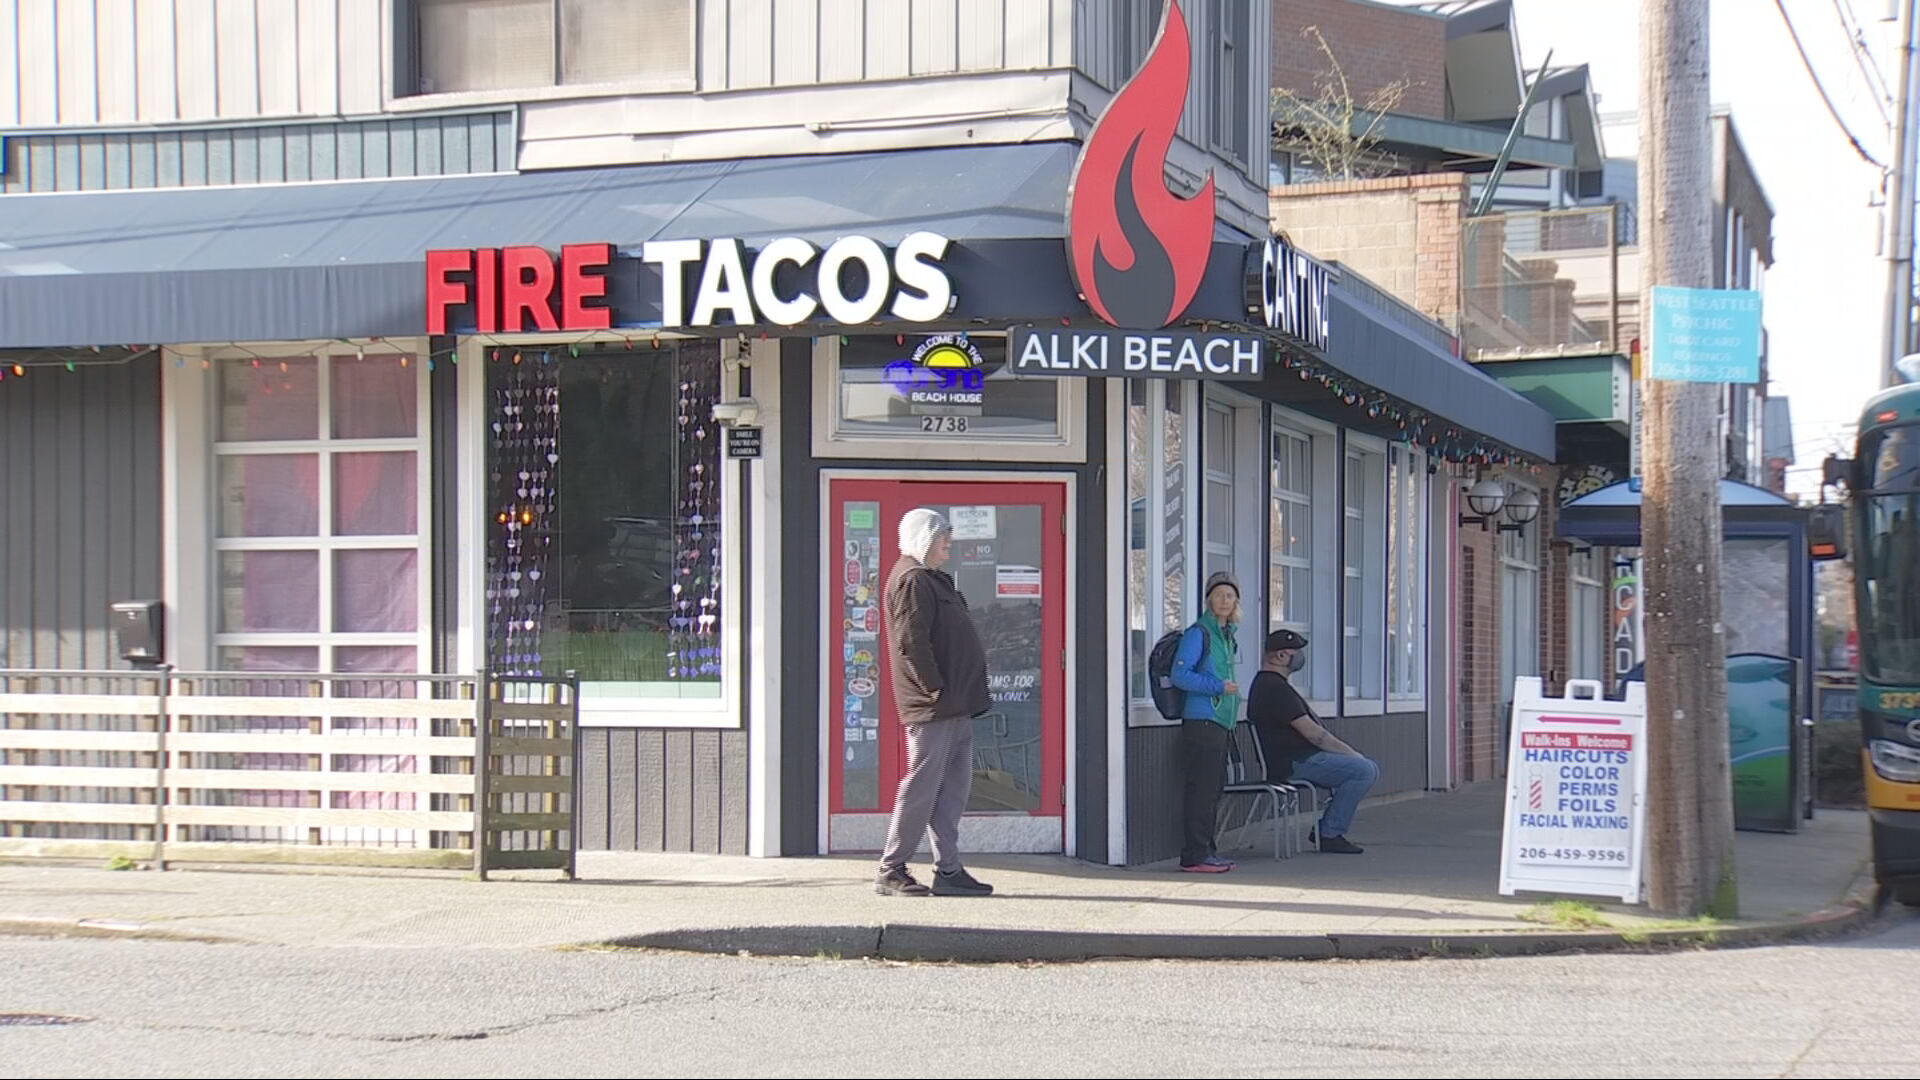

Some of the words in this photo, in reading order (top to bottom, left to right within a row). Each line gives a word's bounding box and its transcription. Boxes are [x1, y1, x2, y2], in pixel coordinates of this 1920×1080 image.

[426, 243, 612, 334] FIRE
[643, 231, 955, 326] TACOS
[1263, 238, 1328, 353] CANTINA
[1694, 296, 1758, 312] SEATTLE
[912, 335, 953, 362] WELCOME
[955, 336, 969, 349] TO
[967, 344, 984, 365] THE
[1018, 334, 1108, 369] ALKI
[1124, 336, 1260, 374] BEACH
[912, 392, 947, 402] BEACH
[949, 393, 983, 403] HOUSE
[923, 416, 967, 432] 2738
[976, 544, 991, 554] NO
[1014, 674, 1034, 688] FOR
[1525, 734, 1572, 747] Walk-Ins
[1577, 735, 1628, 749] Welcome
[1525, 749, 1629, 764] HAIRCUTS
[1559, 766, 1619, 780] COLOR
[1558, 782, 1618, 796] PERMS
[1558, 798, 1616, 813] FOILS
[1520, 814, 1568, 828] FACIAL
[1572, 816, 1629, 830] WAXING
[1520, 847, 1625, 861] 206-459-9596
